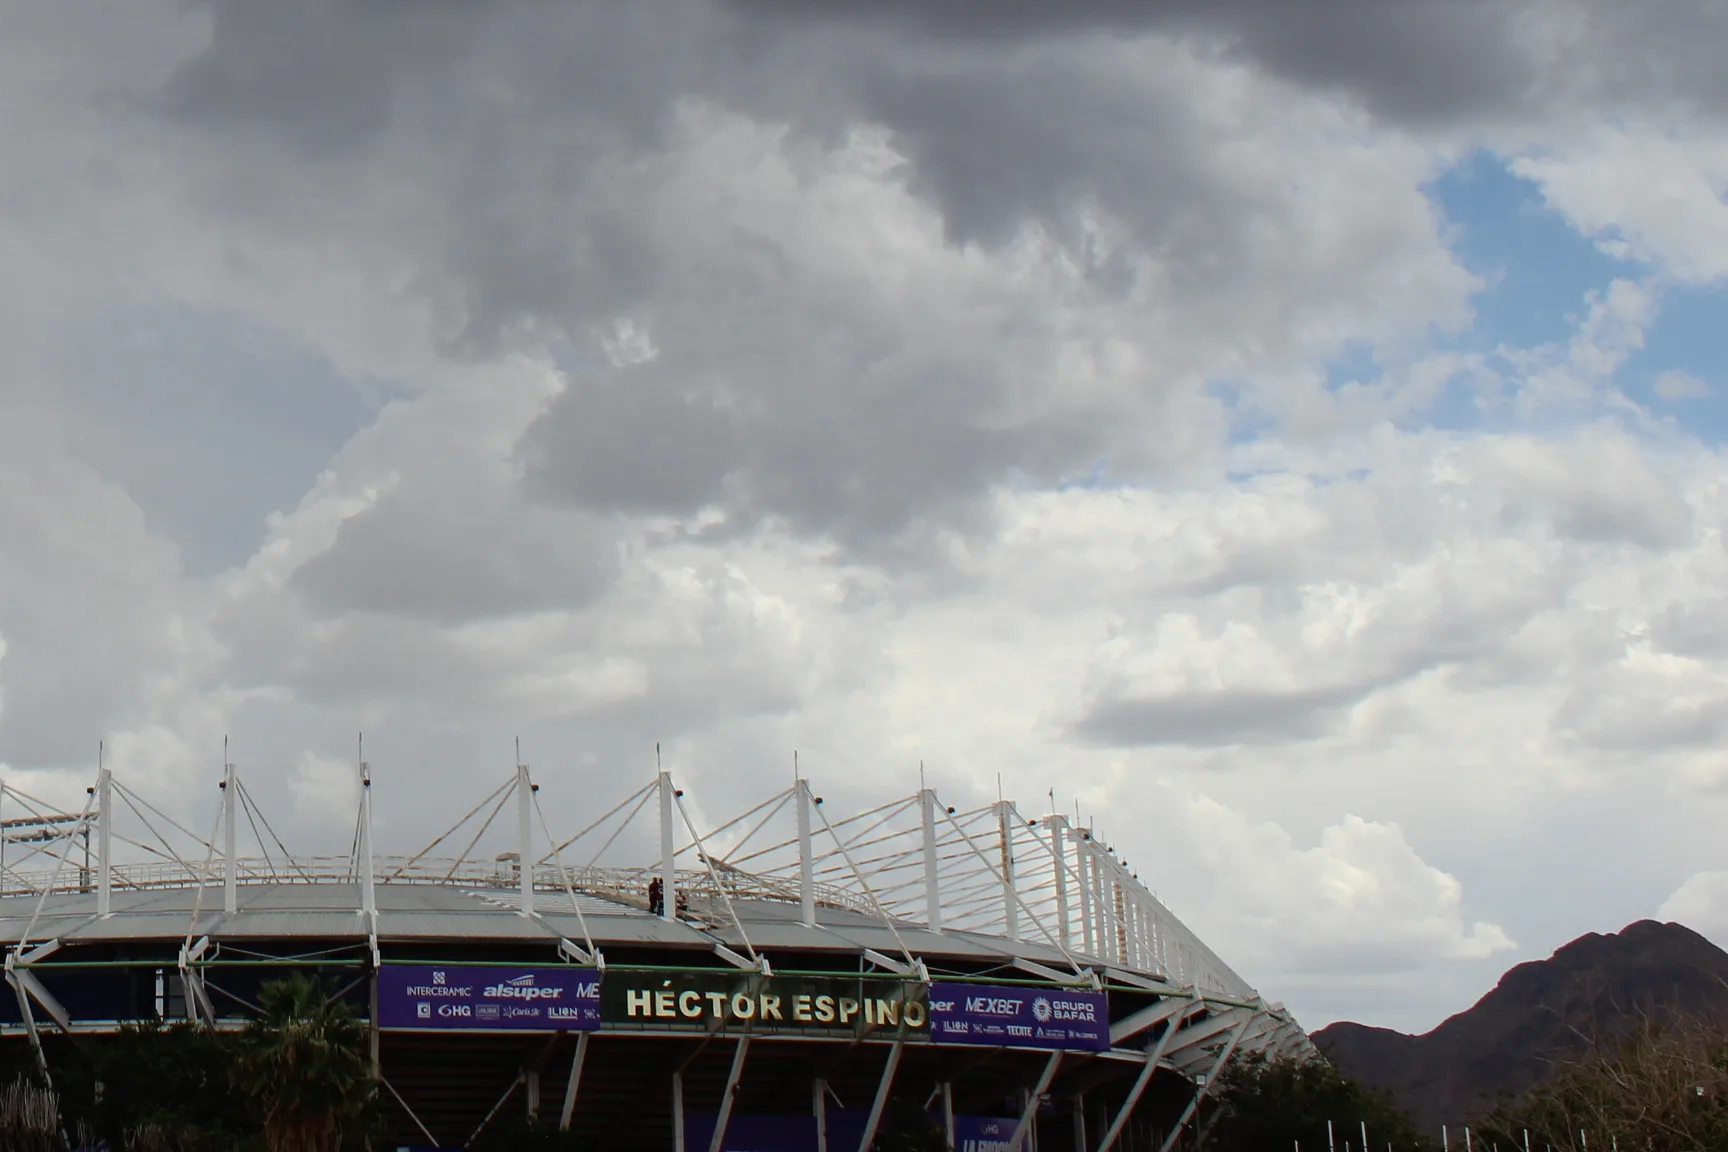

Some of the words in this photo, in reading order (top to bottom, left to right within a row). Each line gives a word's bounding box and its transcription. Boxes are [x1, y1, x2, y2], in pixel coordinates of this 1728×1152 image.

[406, 986, 472, 997] INTERCERAMIC
[483, 983, 563, 1000] alsuper
[626, 980, 783, 1020] HÉCTOR
[792, 995, 926, 1027] ESPINO
[965, 996, 1023, 1015] MEXBET
[1052, 1001, 1095, 1012] GRUPO
[1054, 1010, 1097, 1022] BAFAR
[1006, 1025, 1032, 1037] TECATE
